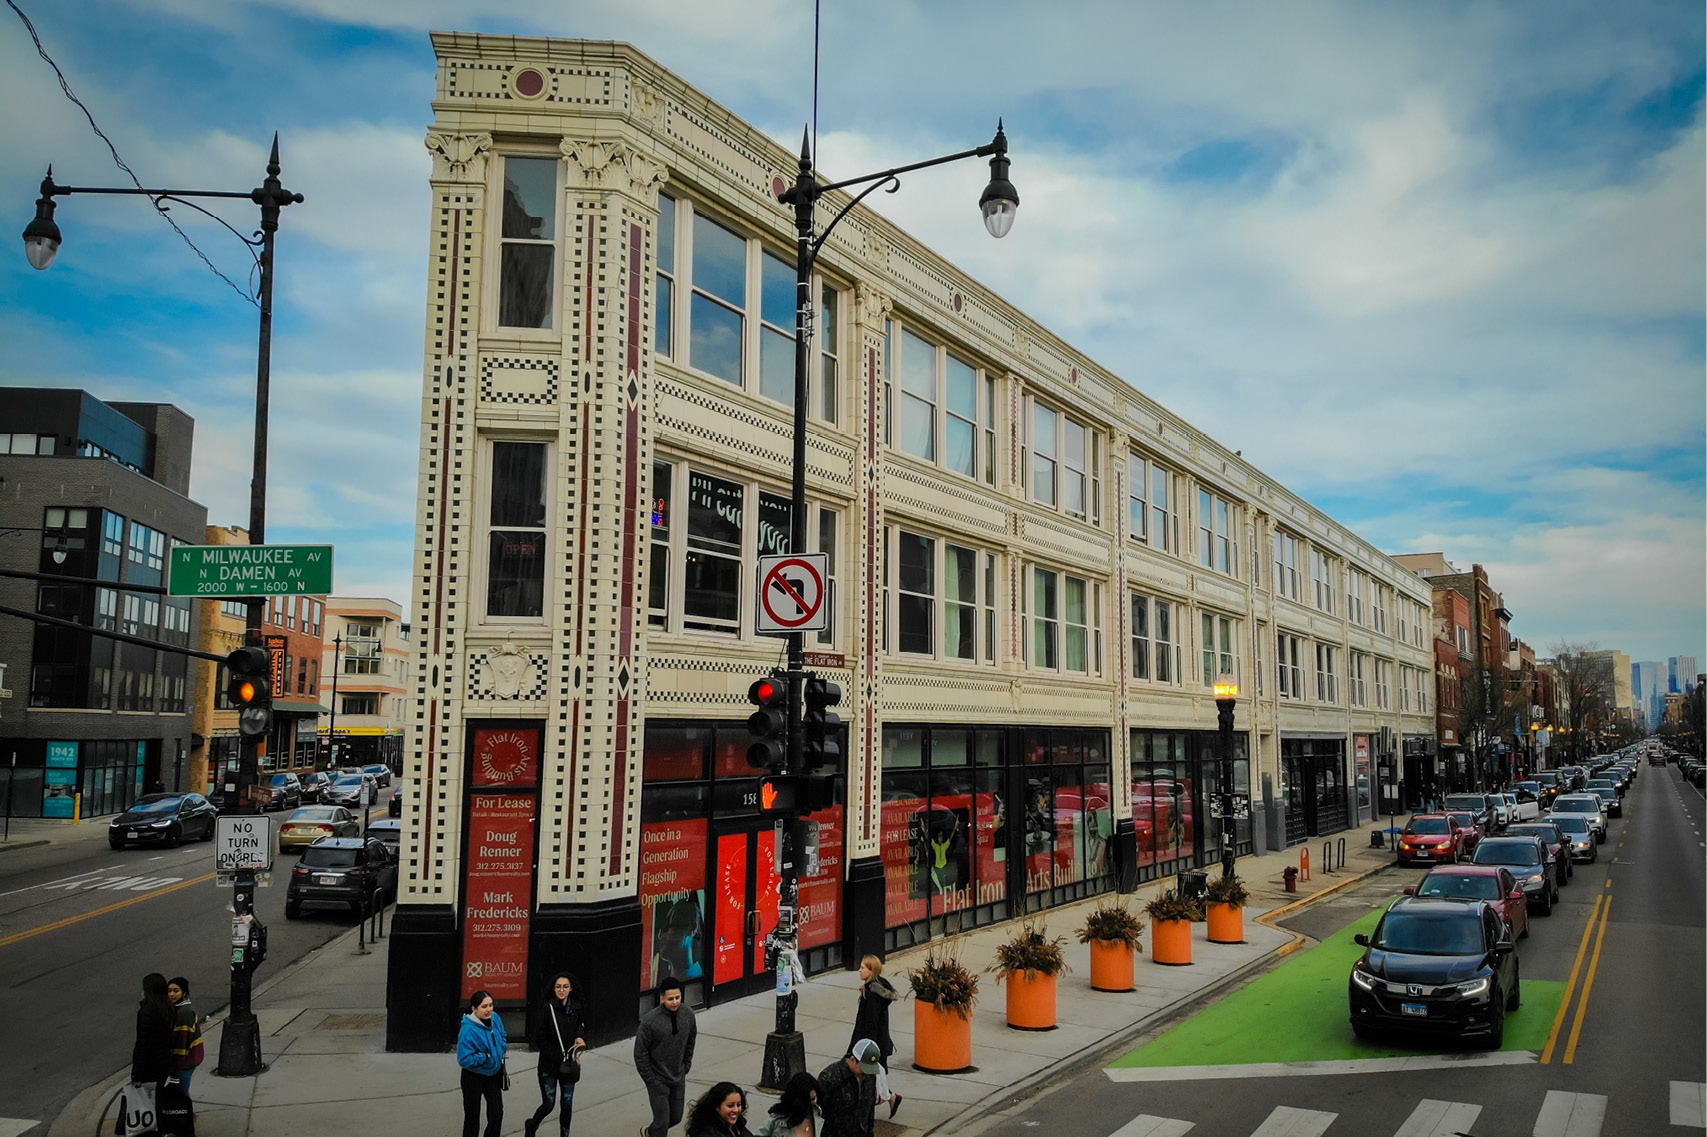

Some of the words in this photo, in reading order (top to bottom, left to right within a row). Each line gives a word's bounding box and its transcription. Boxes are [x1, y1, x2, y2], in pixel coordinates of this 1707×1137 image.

[182, 552, 191, 562] N
[202, 549, 294, 564] MILWAUKEE
[306, 552, 322, 562] AV
[199, 569, 207, 578] N
[219, 566, 276, 580] DAMEN
[287, 568, 303, 578] AV
[197, 582, 227, 592] 2000
[236, 583, 245, 592] W
[263, 582, 288, 592] 1600
[297, 581, 305, 591] N
[803, 656, 813, 665] THE
[814, 657, 826, 666] FLAT
[827, 658, 838, 667] IRON
[486, 732, 508, 748] Flat
[510, 733, 528, 753] Iron
[50, 746, 75, 757] 1942
[481, 752, 514, 782] Building
[514, 754, 531, 776] Arts
[475, 797, 495, 809] For
[497, 797, 532, 809] Lease
[887, 811, 919, 825] AVAILABLE
[233, 823, 253, 833] NO
[886, 831, 900, 843] FOR
[899, 828, 919, 842] LEASE
[228, 838, 259, 848] TURN
[486, 830, 518, 845] Doug
[643, 830, 666, 844] Once
[666, 828, 675, 841] in
[675, 829, 682, 840] a
[220, 853, 236, 863] ON
[479, 845, 522, 857] Renner
[642, 847, 689, 865] Generation
[887, 846, 919, 861] AVAILABLE
[475, 862, 524, 870] 312.275.3137
[819, 855, 839, 867] dericks
[641, 868, 678, 887] Flagship
[887, 863, 919, 879] AVAILABLE
[887, 880, 919, 897] AVAILABLE
[943, 882, 971, 914] Flat
[976, 879, 1005, 906] Iron
[1026, 868, 1051, 894] Arts
[483, 891, 513, 903] Mark
[641, 886, 692, 909] Opportunity
[466, 906, 529, 919] Fredericks
[810, 901, 836, 917] BAUM
[887, 899, 919, 916] AVAILABLE
[472, 923, 521, 932] 312.275.3109
[484, 962, 523, 973] BAUM
[127, 1109, 154, 1128] UO
